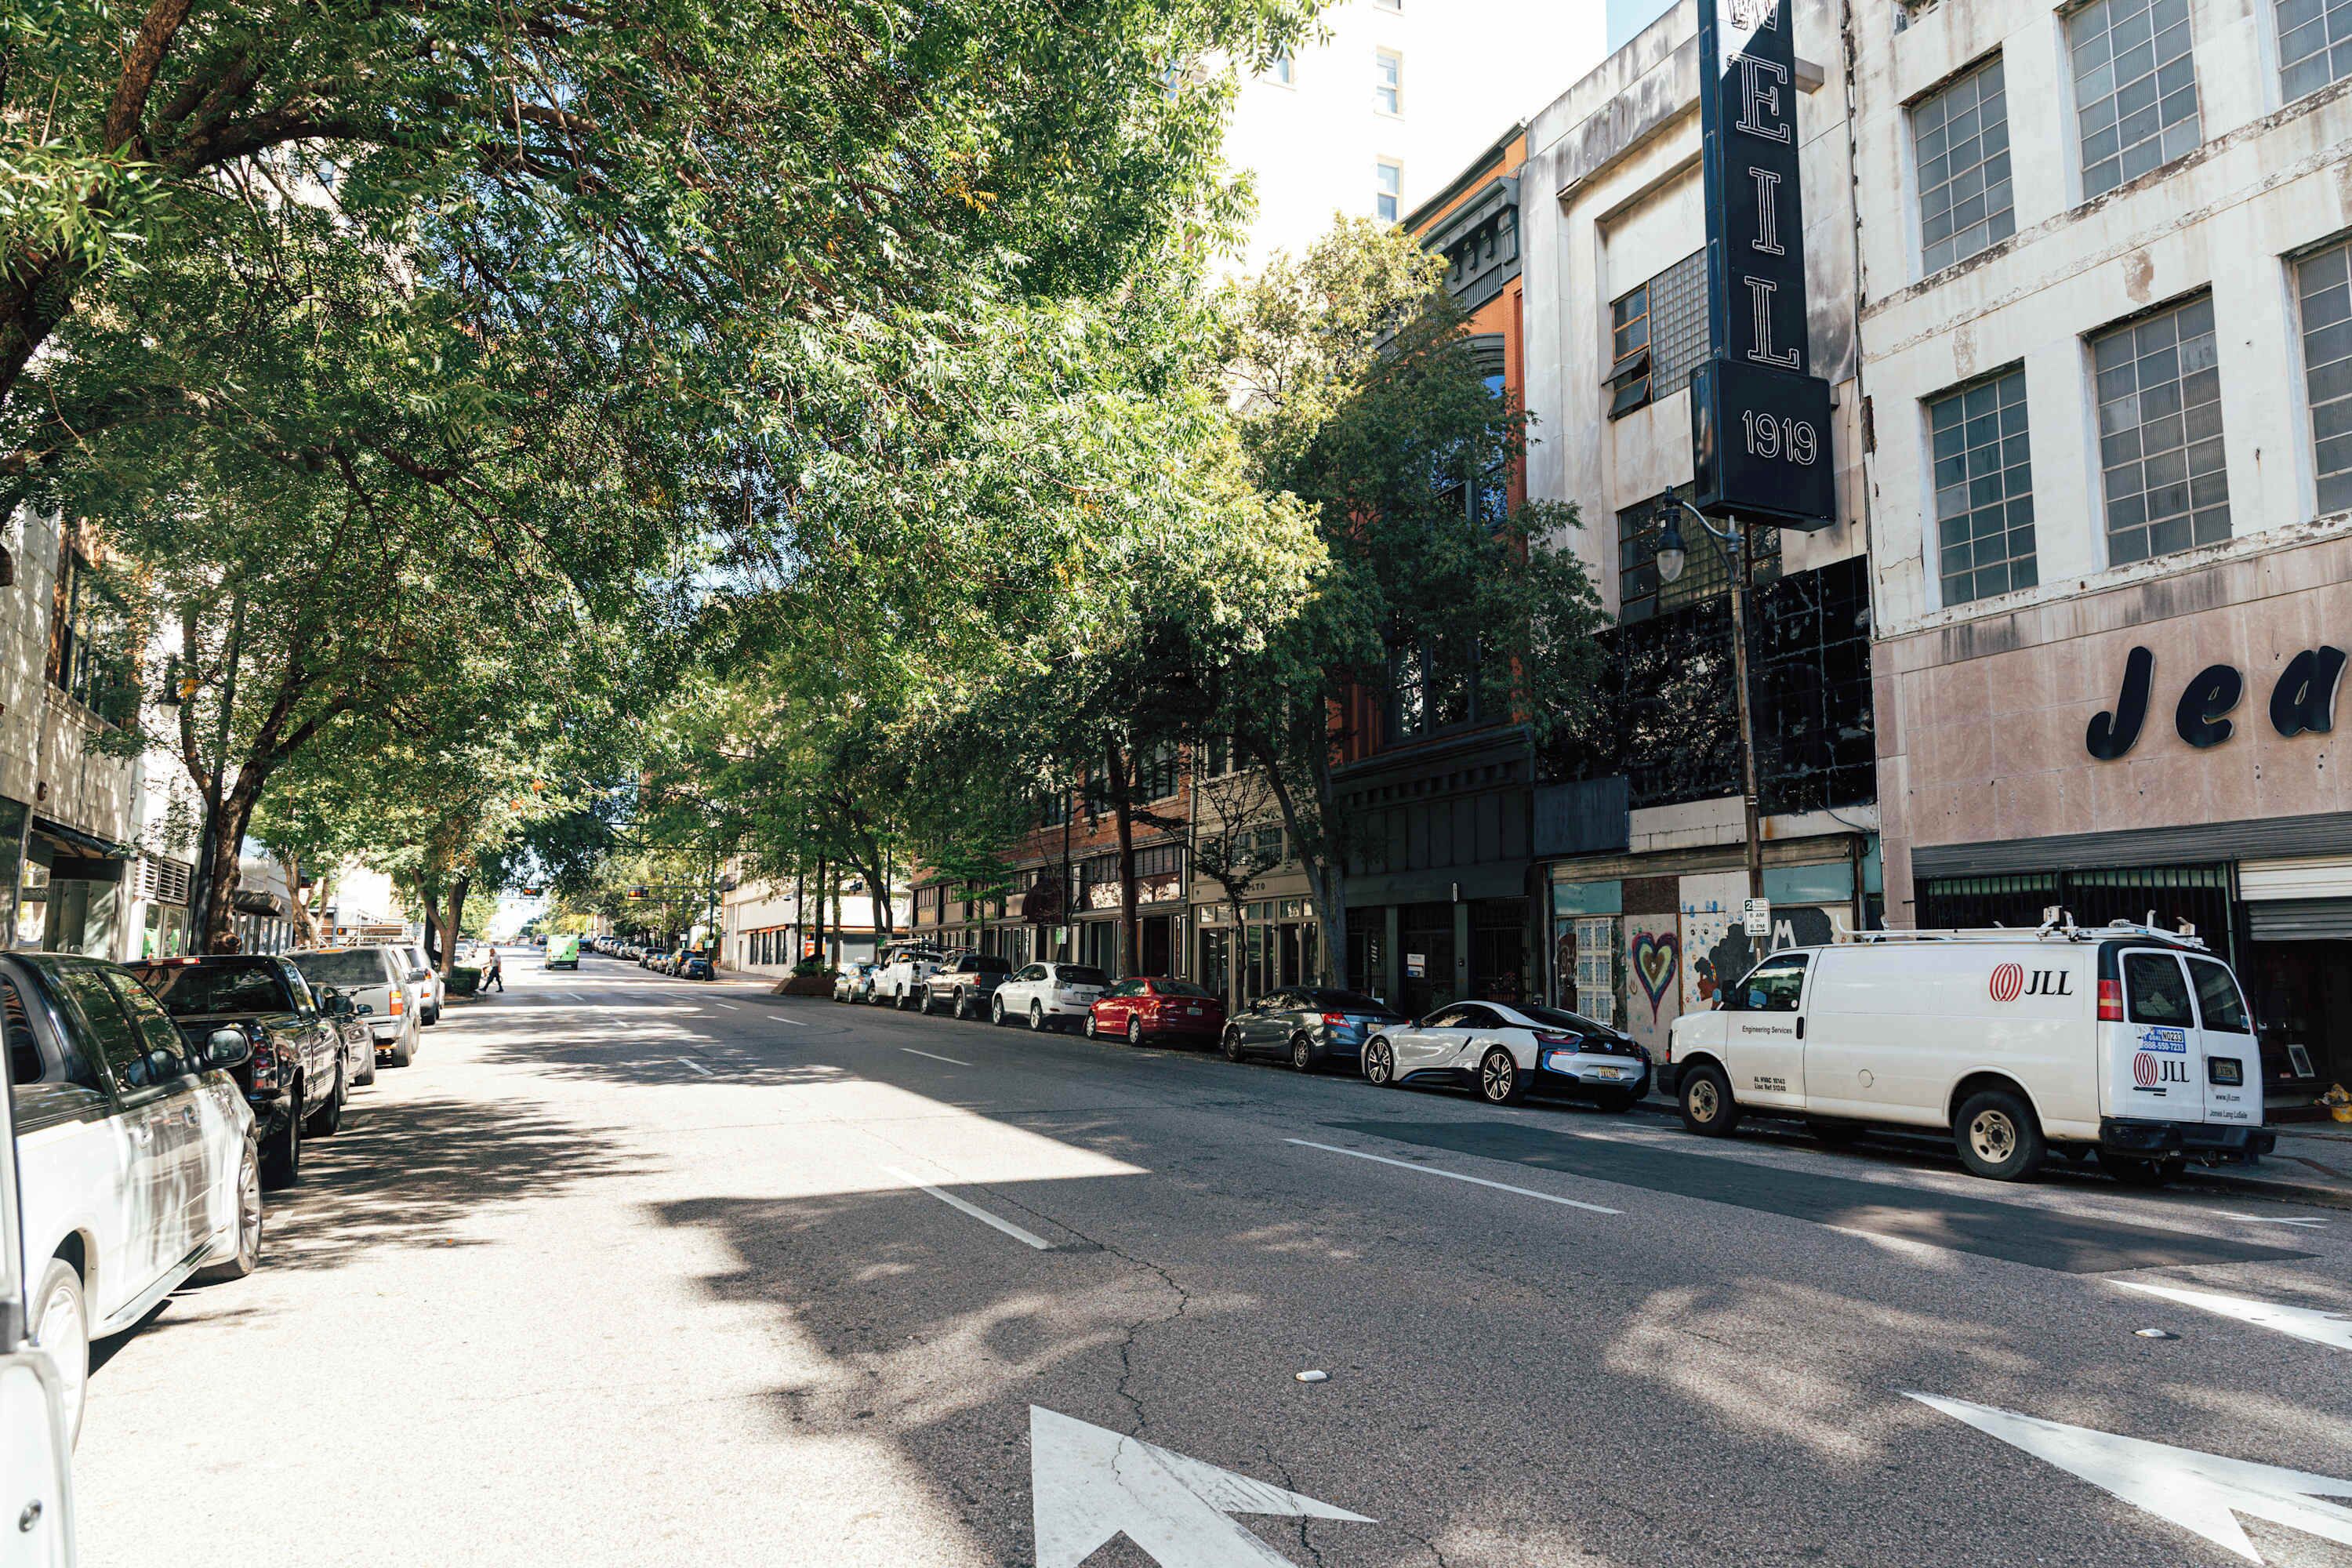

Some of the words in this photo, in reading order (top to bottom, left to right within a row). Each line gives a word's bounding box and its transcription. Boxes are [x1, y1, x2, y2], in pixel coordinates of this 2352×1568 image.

[1742, 409, 1817, 465] 1919
[2085, 645, 2347, 760] Jea
[1745, 902, 1752, 910] 2
[2024, 971, 2074, 996] JLL
[1742, 1025, 1770, 1035] Engineering
[2160, 1060, 2190, 1083] JLL
